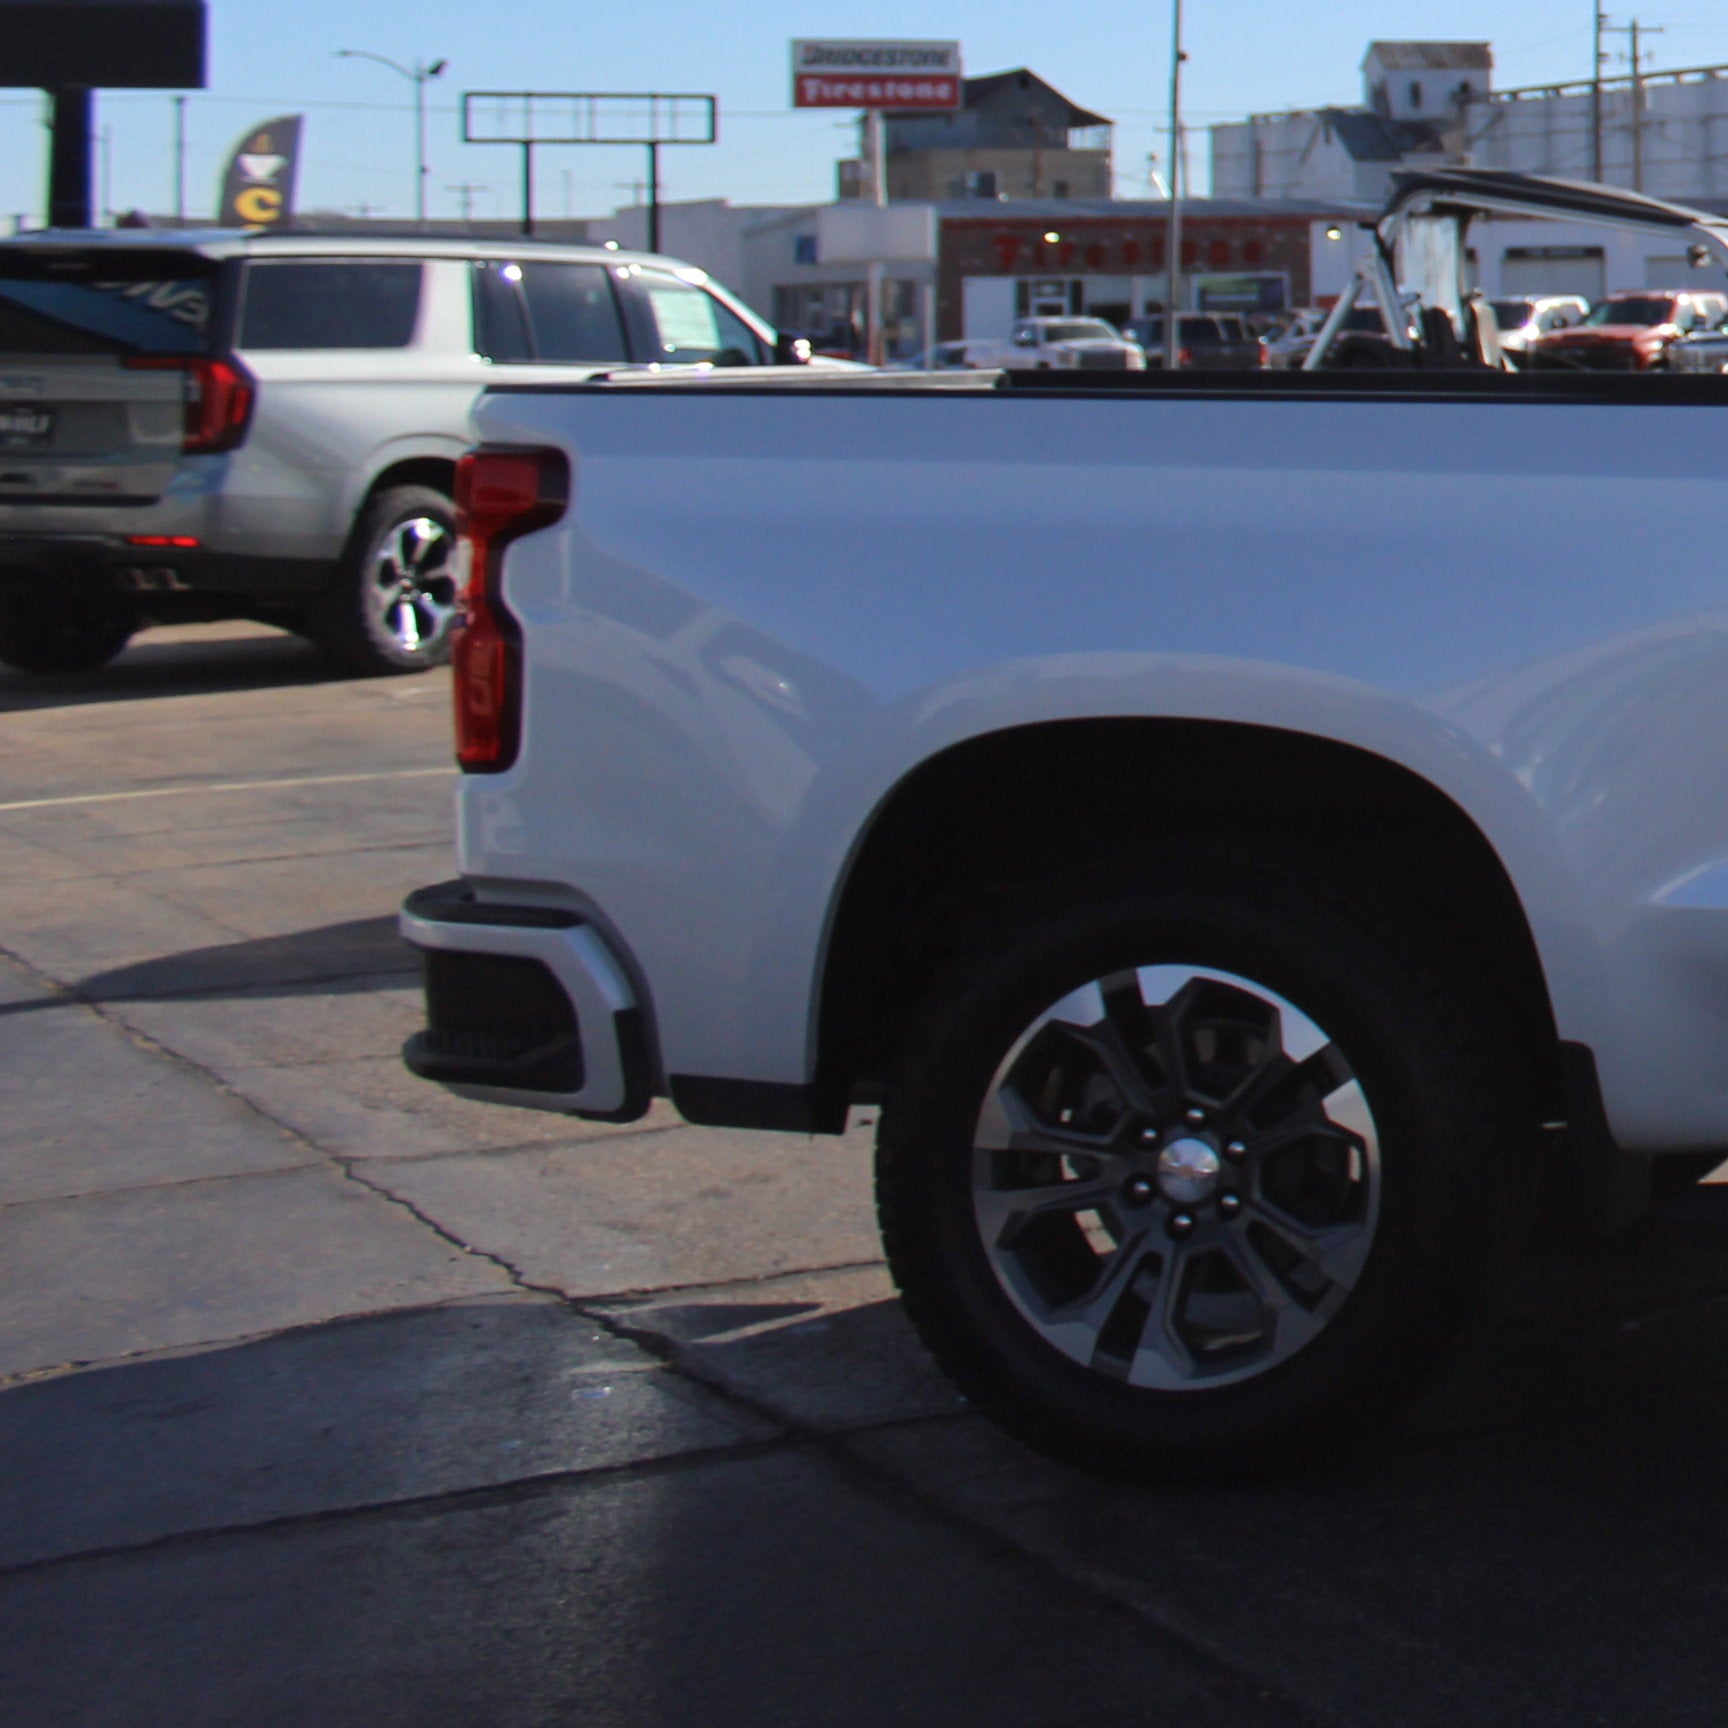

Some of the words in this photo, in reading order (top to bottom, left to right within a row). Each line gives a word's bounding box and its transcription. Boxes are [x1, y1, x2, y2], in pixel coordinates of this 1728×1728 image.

[802, 44, 951, 66] BRIDGESTONE
[803, 79, 952, 104] Firestone
[234, 187, 283, 229] C
